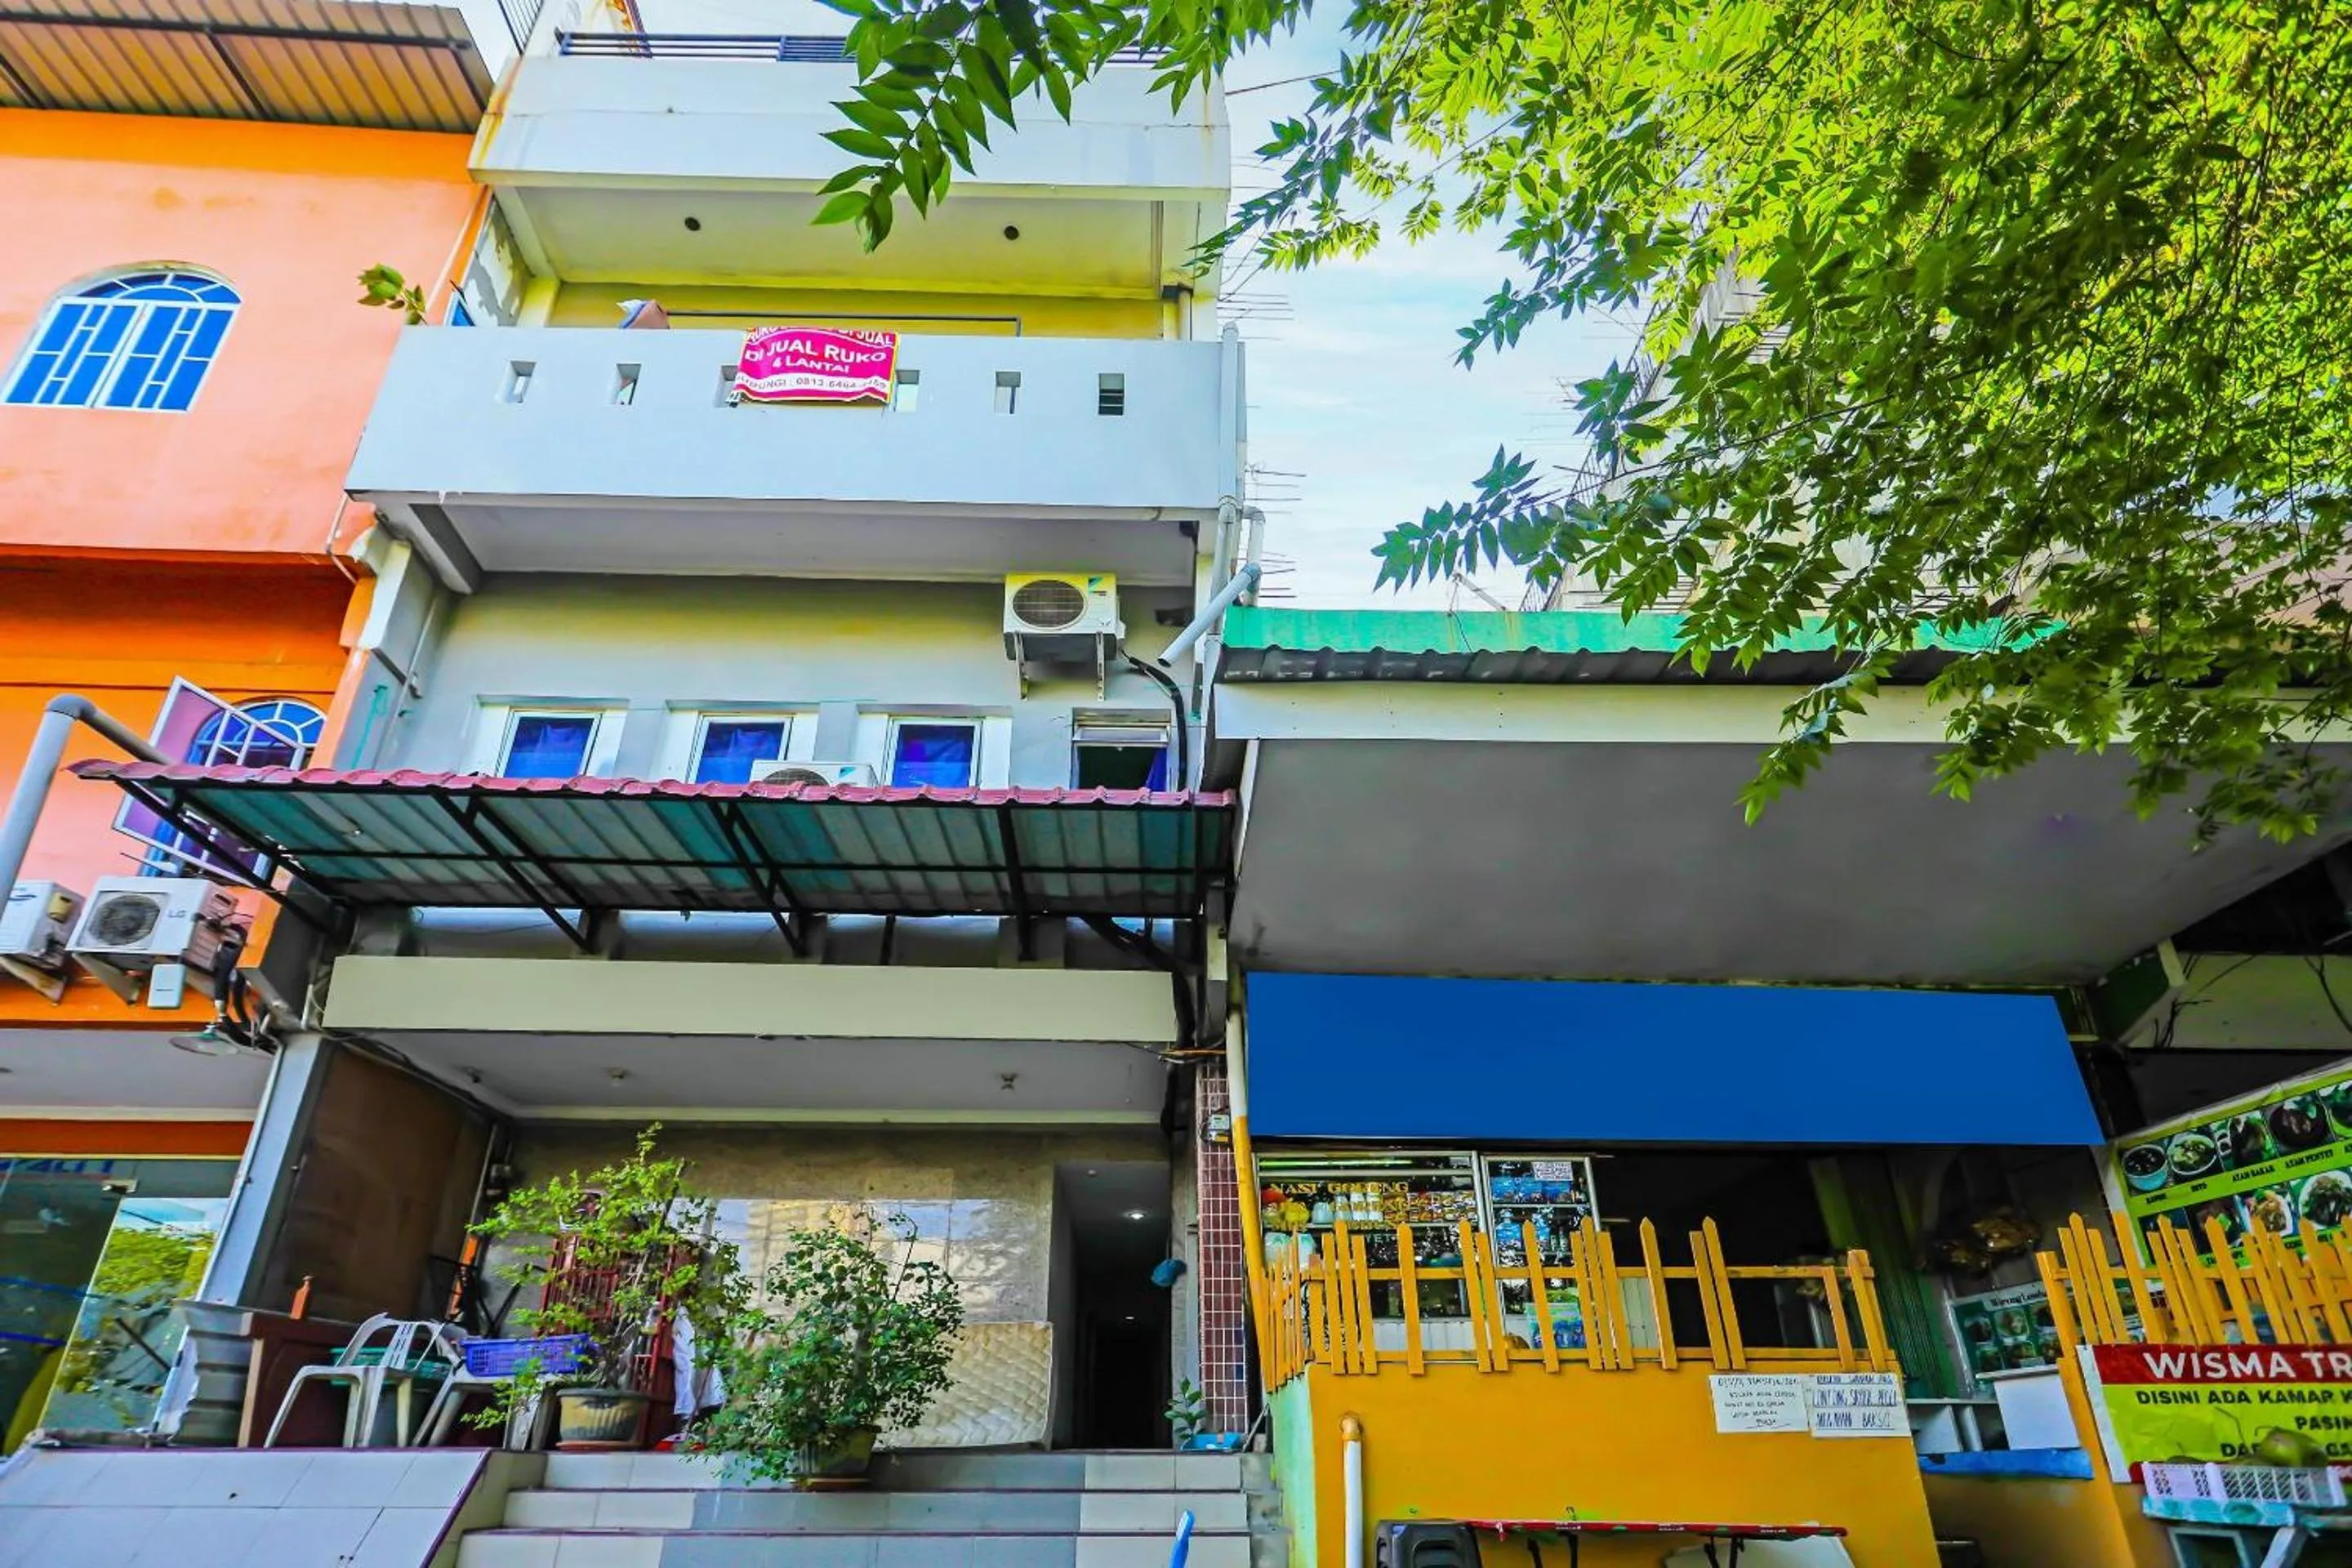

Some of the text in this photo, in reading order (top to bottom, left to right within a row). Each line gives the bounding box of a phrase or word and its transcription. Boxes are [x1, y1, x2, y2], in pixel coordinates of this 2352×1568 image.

[766, 339, 819, 358] JUAL
[824, 344, 887, 363] RUKO
[773, 356, 850, 374] 4 LANTAI
[167, 909, 188, 919] LG
[2143, 1352, 2352, 1379] WISMA TR
[2136, 1390, 2201, 1405] DISINI
[2207, 1390, 2252, 1405] ADA
[2258, 1389, 2334, 1405] KAMAR
